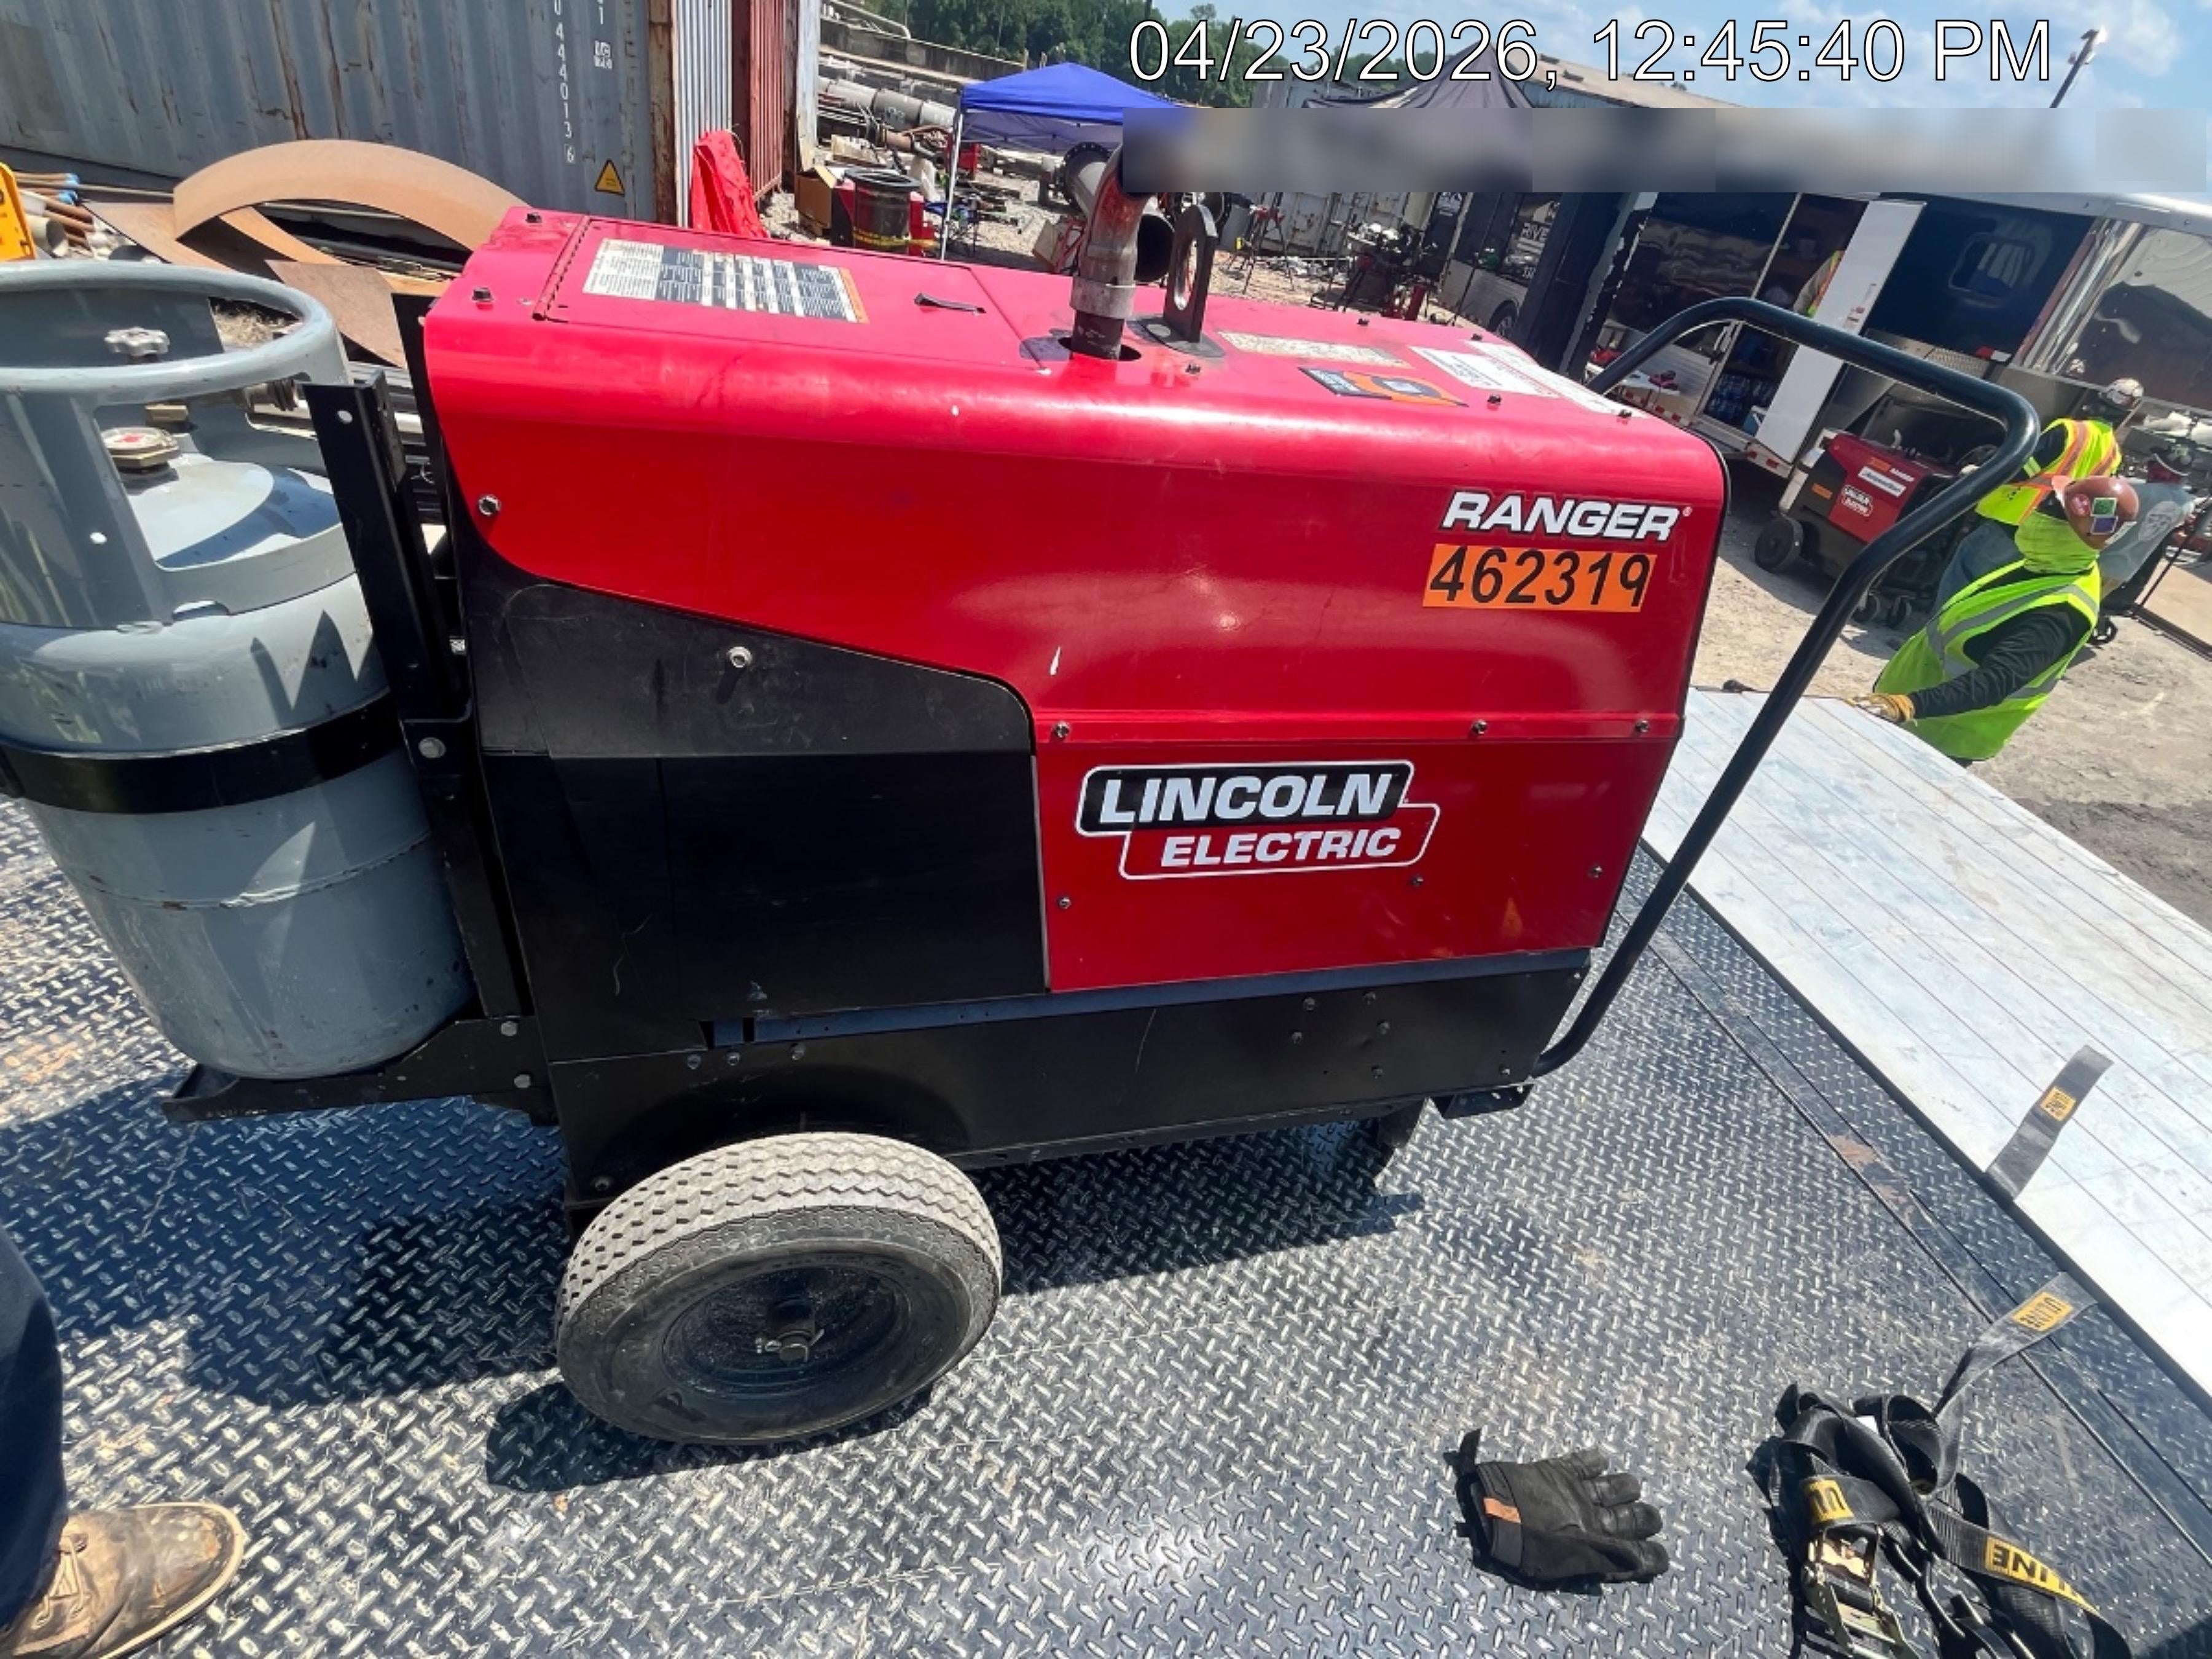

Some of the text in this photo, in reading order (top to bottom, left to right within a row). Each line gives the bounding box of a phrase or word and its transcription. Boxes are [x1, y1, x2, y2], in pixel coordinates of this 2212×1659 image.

[1441, 492, 1680, 541] RANGER
[1429, 545, 1651, 607] 462319
[1099, 774, 1391, 823] LINCOLN
[1161, 828, 1401, 867] ELECTRIC
